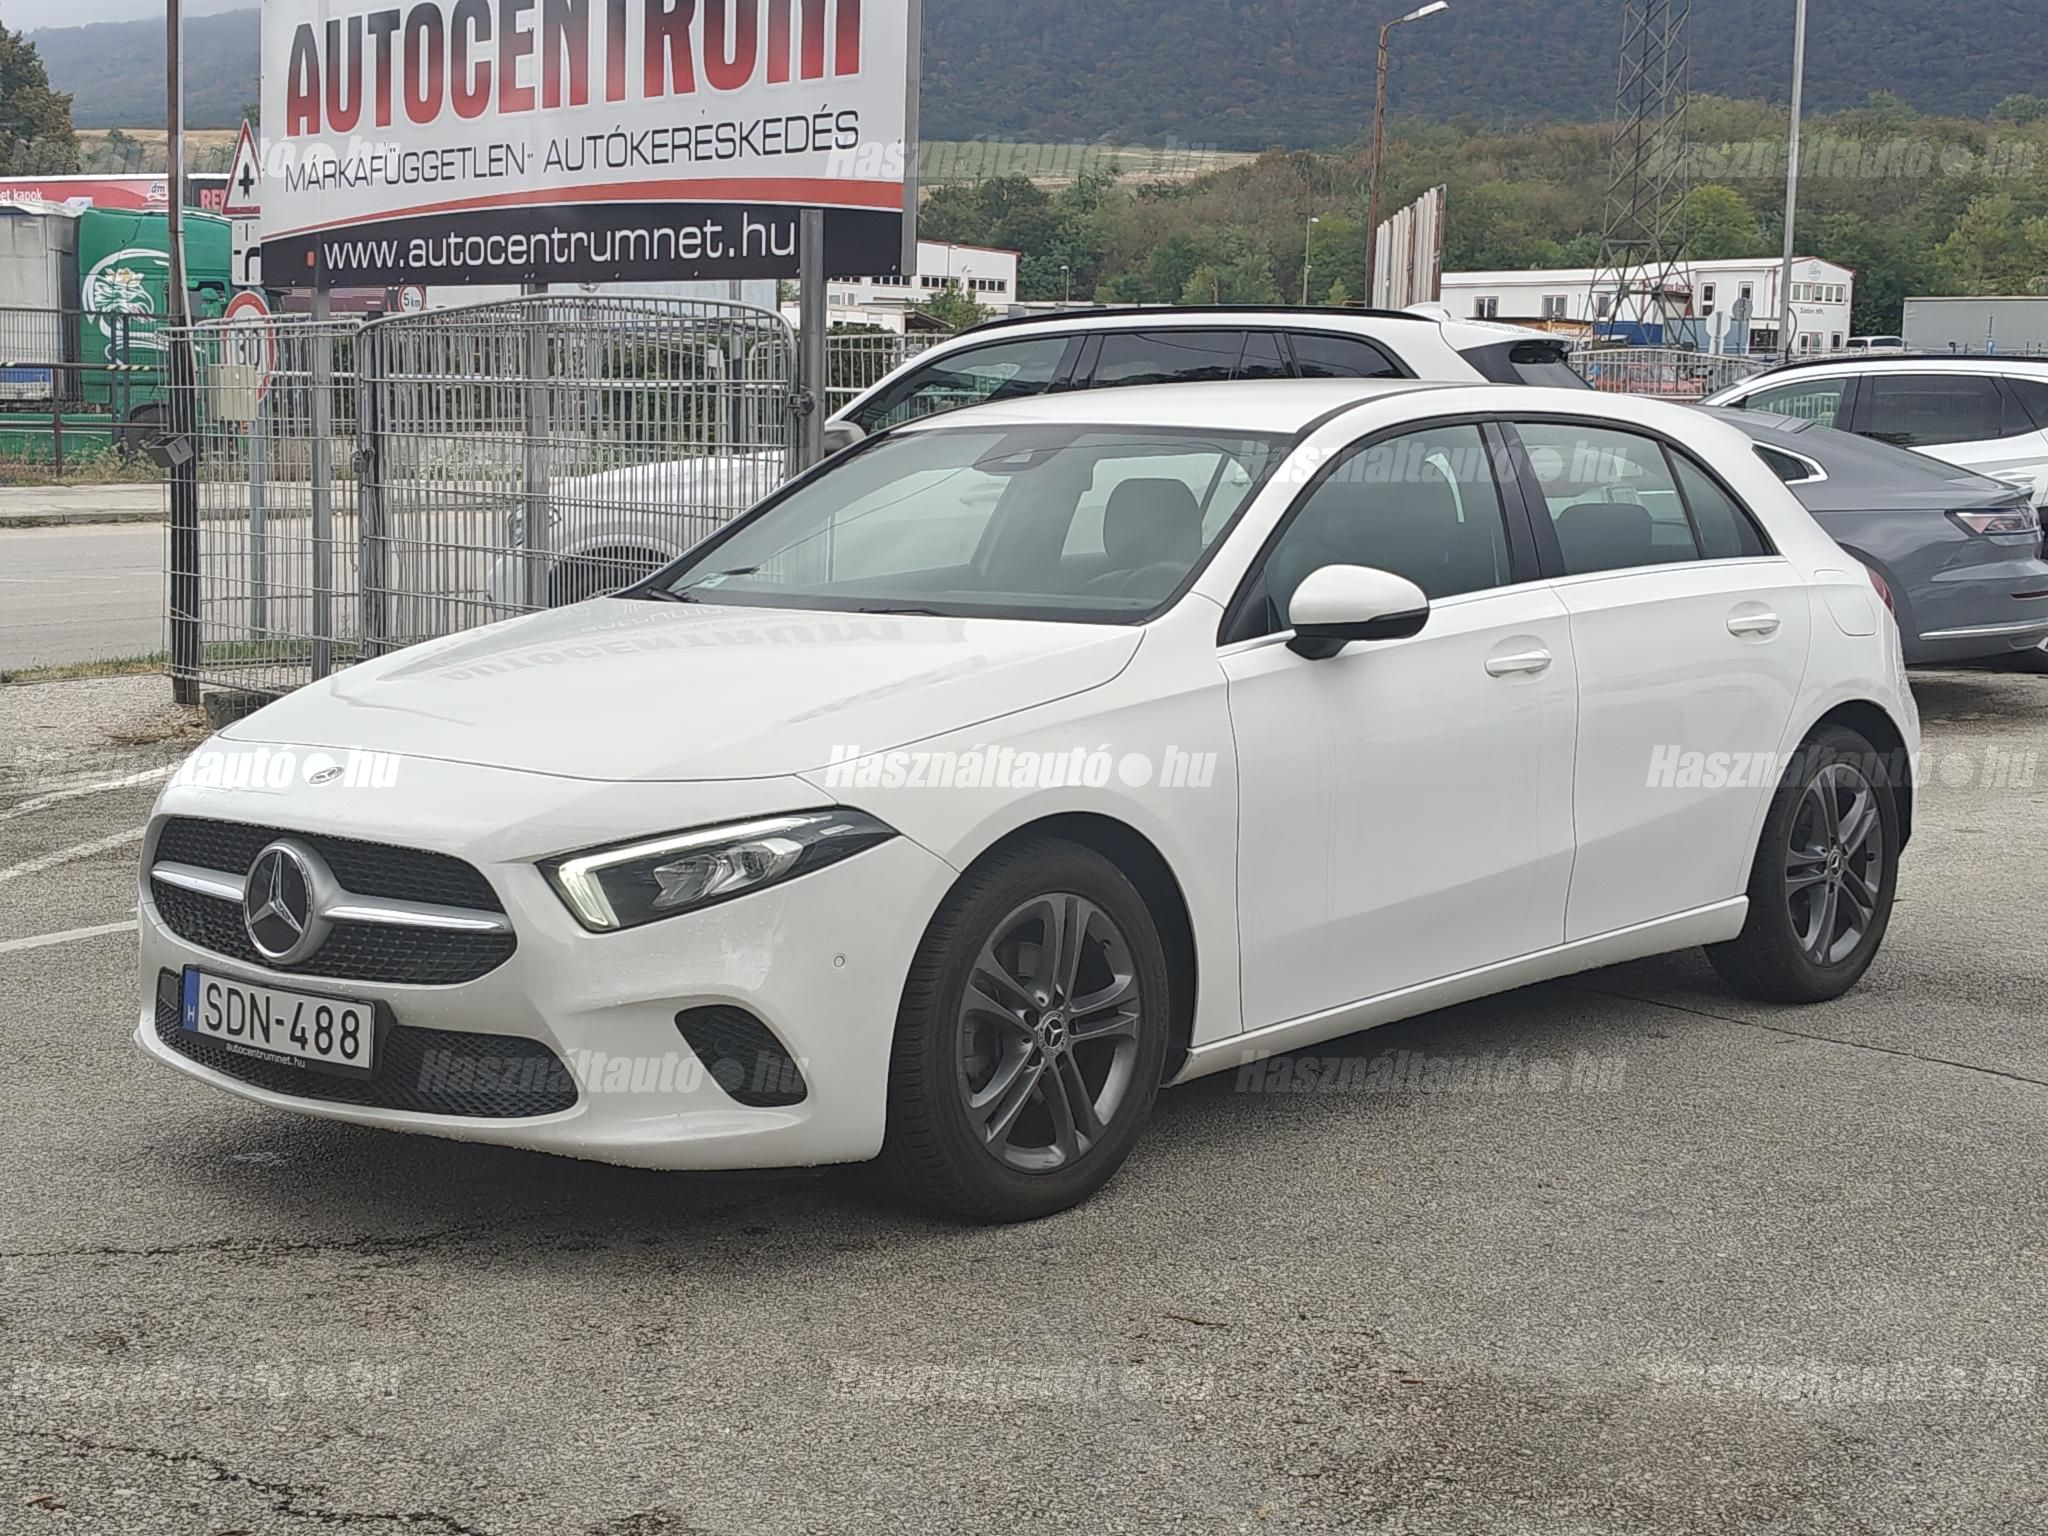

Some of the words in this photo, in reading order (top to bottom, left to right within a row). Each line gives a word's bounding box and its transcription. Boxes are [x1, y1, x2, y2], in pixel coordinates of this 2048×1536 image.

[285, 142, 526, 193] MÁRKAFÜGGETLEN
[543, 104, 859, 173] AUTÓKERESKEDÉS
[200, 189, 226, 209] RE
[323, 211, 796, 270] www.autocentrumnet.hu
[204, 983, 361, 1060] SDN-488
[226, 1041, 307, 1069] autocentrumnet.hu
